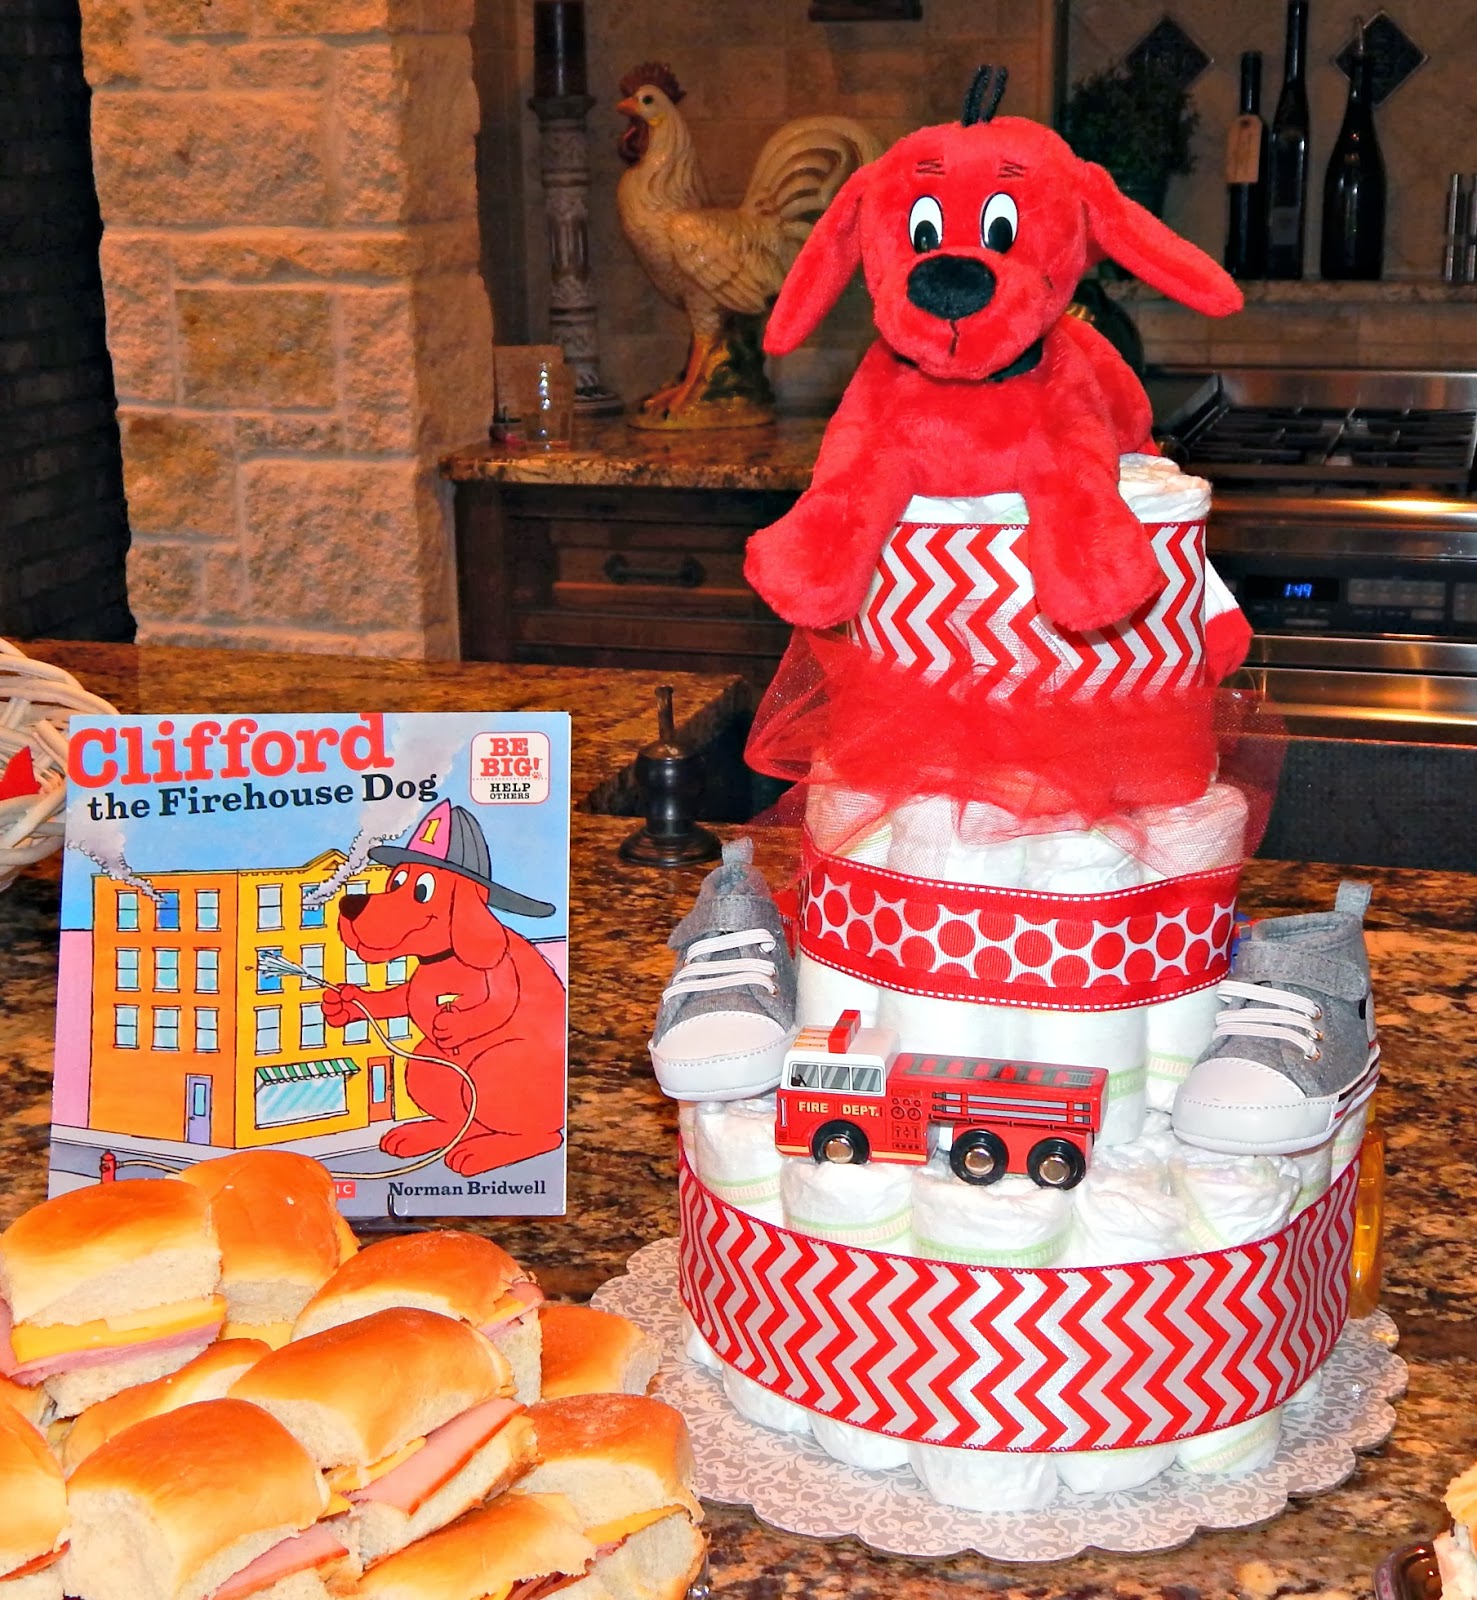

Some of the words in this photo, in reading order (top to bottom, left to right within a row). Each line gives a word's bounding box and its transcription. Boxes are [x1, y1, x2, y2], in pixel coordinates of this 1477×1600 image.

[68, 713, 395, 787] Clifford
[490, 738, 528, 756] BE
[480, 757, 541, 779] BIG!
[489, 782, 531, 792] HELP
[489, 792, 530, 800] OTHERS
[88, 792, 150, 820] the
[158, 782, 354, 816] Firehouse
[362, 773, 438, 802] Dog
[419, 817, 441, 845] 1
[798, 1101, 829, 1114] FIRE
[841, 1104, 880, 1117] DEPT.
[388, 1182, 462, 1196] Norman
[467, 1180, 546, 1195] Bridwell
